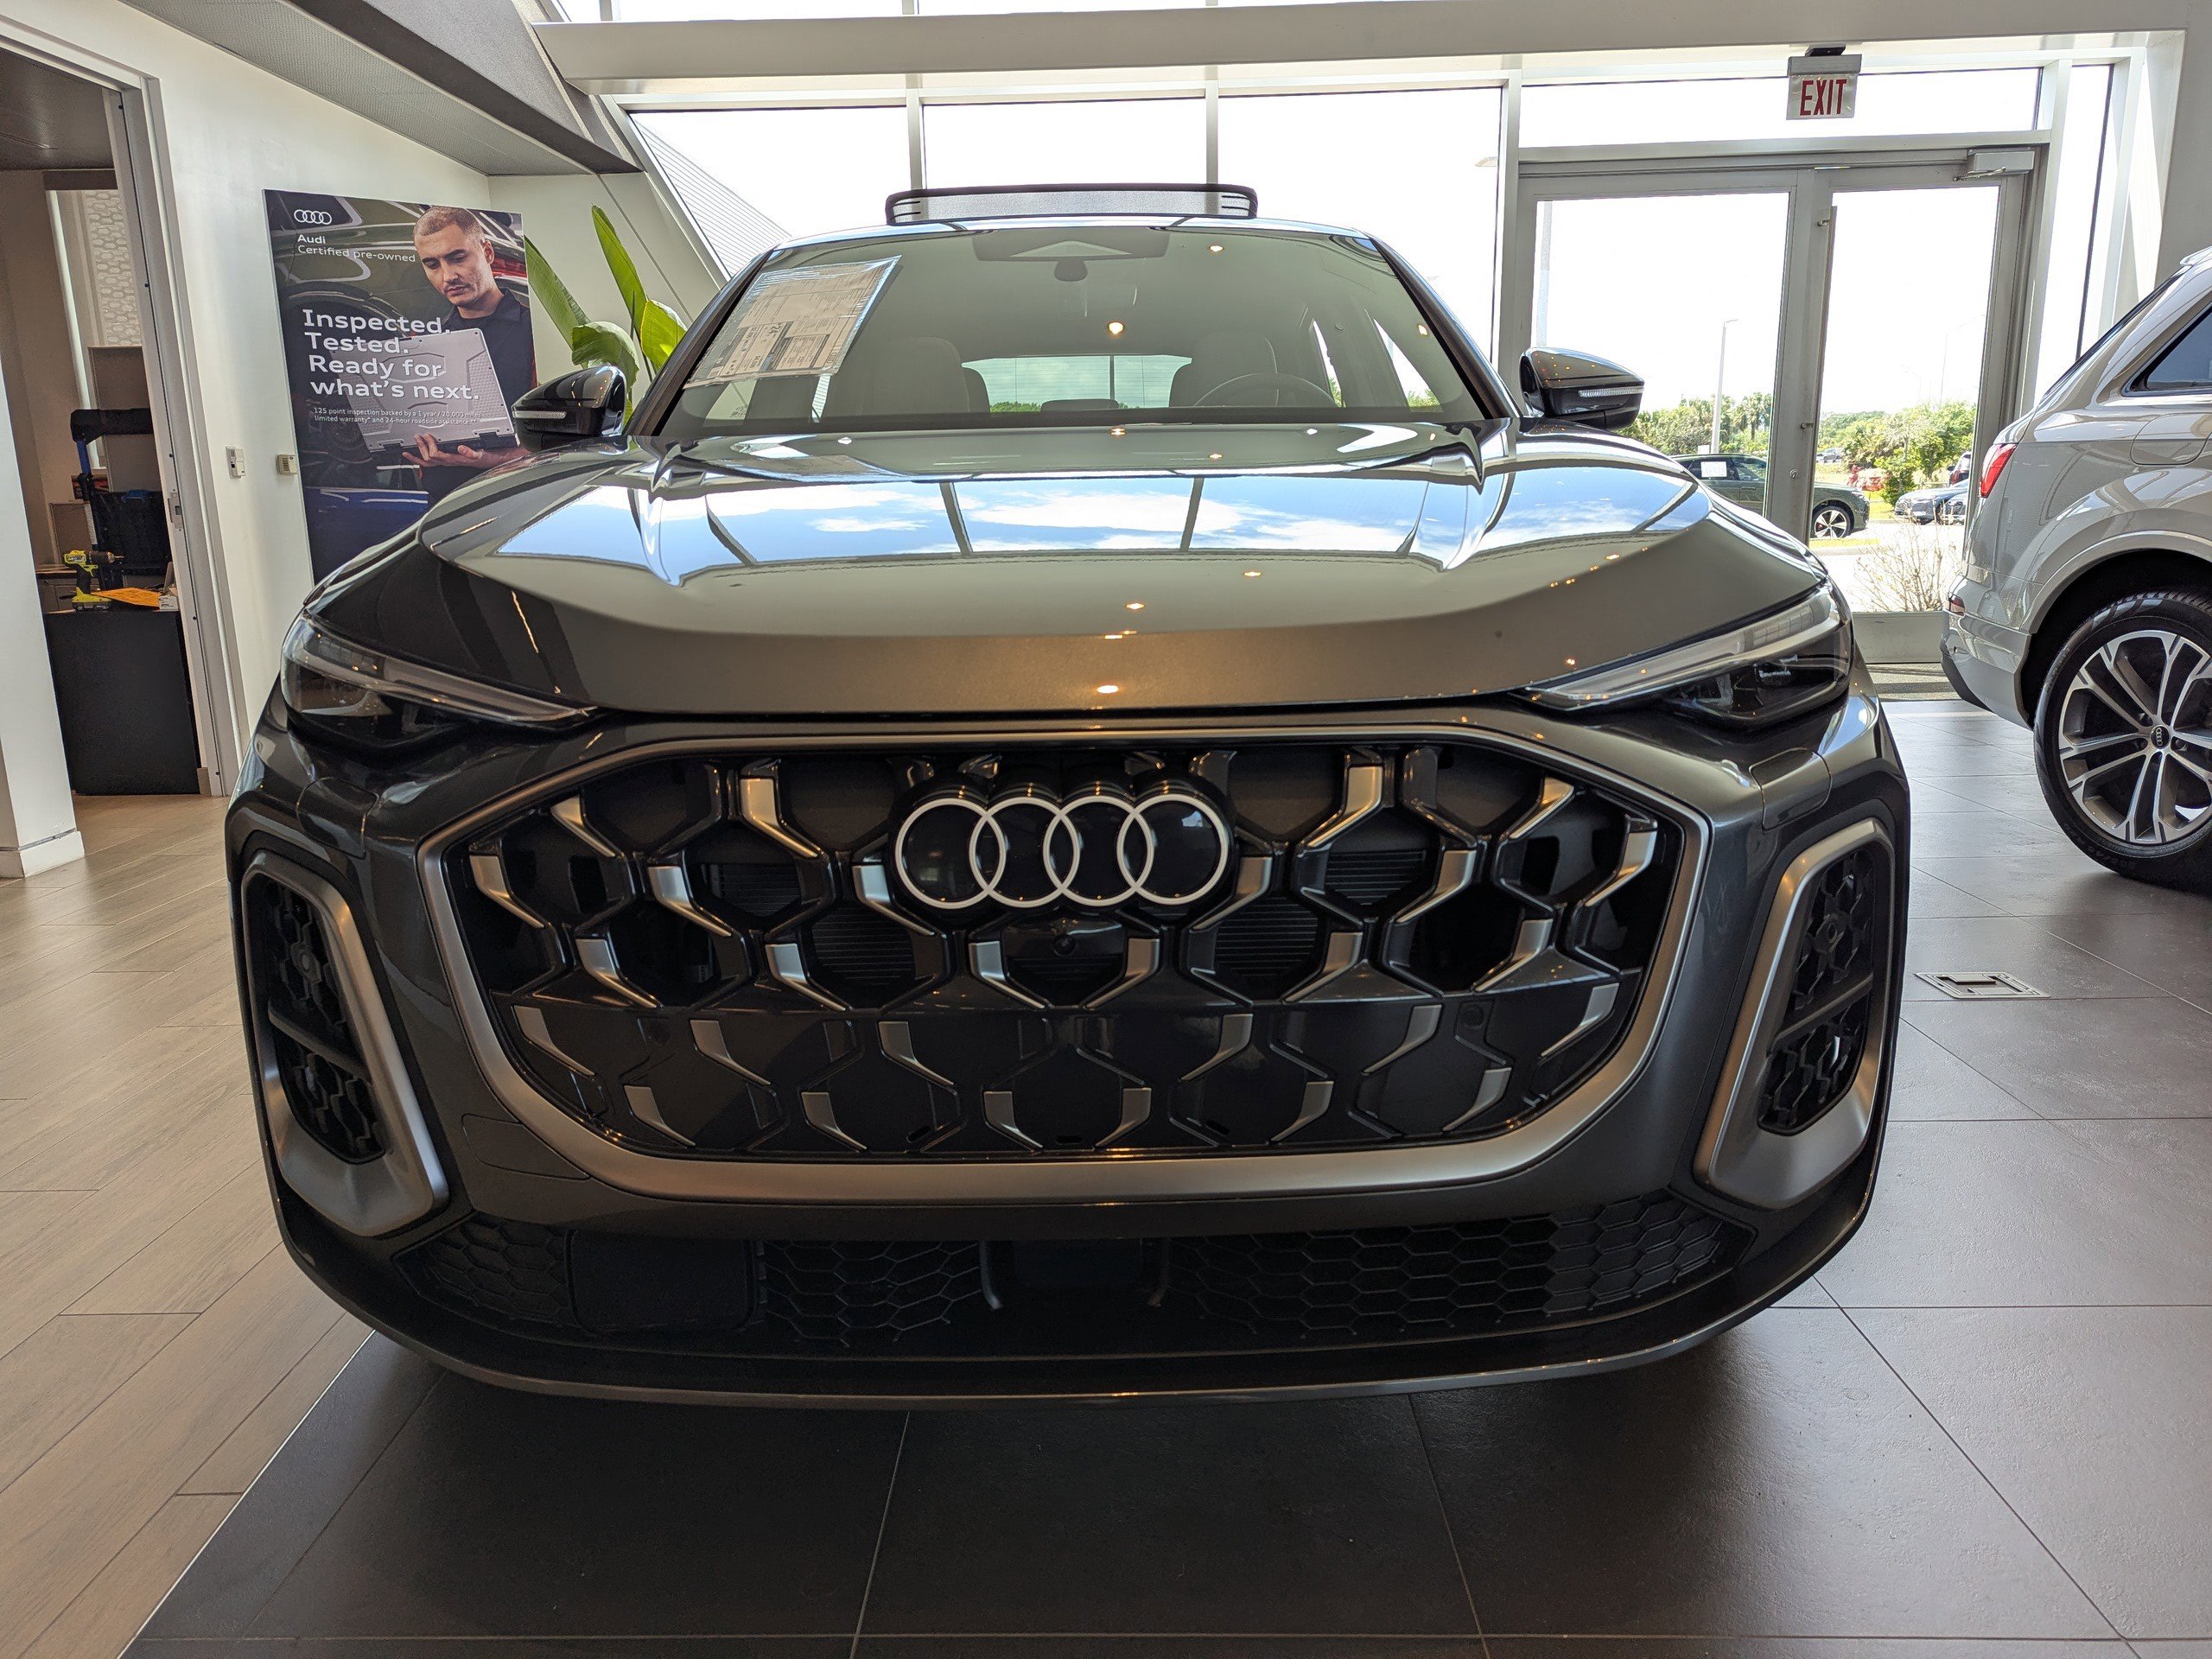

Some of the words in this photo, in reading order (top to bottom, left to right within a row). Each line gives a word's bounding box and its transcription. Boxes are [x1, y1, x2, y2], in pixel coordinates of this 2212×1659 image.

[1800, 79, 1847, 116] EXIT
[297, 234, 326, 245] Audi
[298, 245, 349, 257] Certified
[353, 250, 416, 262] pre-owned
[302, 308, 450, 334] Inspected.
[304, 332, 409, 353] Tested.
[308, 354, 395, 379] Ready
[403, 359, 442, 377] for
[310, 378, 404, 397] what's
[413, 384, 480, 400] next.
